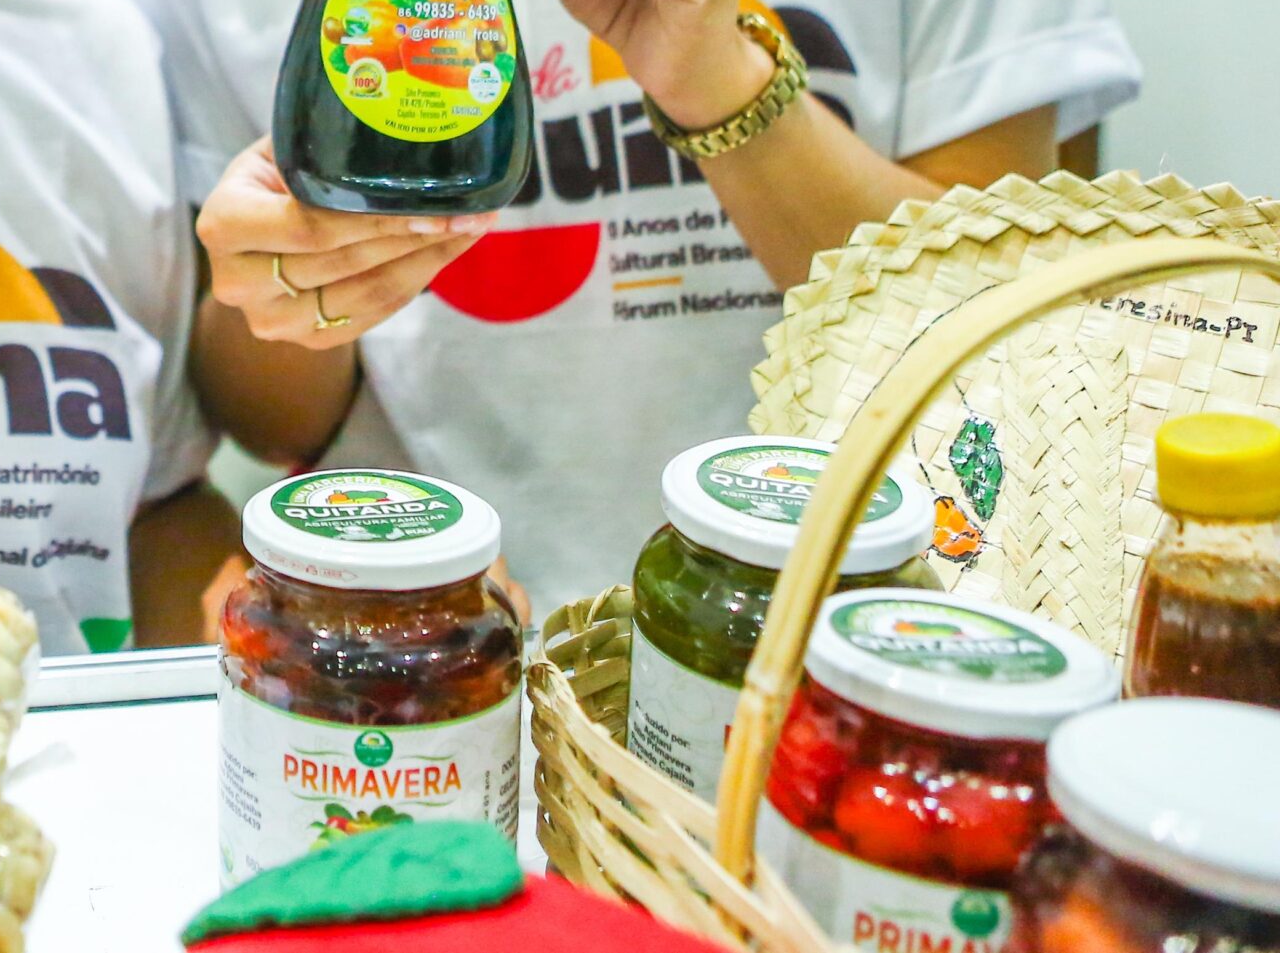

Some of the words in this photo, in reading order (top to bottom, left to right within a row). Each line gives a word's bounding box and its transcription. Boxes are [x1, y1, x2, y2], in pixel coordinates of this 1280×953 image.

[398, 8, 412, 18] 86
[415, 1, 455, 19] 99835
[468, 5, 497, 21] 6439
[623, 218, 679, 237] Anos
[685, 210, 715, 232] de
[1089, 297, 1258, 344] eresina-PI
[720, 490, 809, 507] AGRICULTUR
[284, 501, 451, 520] QUITANDA
[304, 517, 389, 528] AGRICULTURA
[390, 514, 446, 524] FAMILIAR
[283, 754, 462, 800] PRIMAVERA
